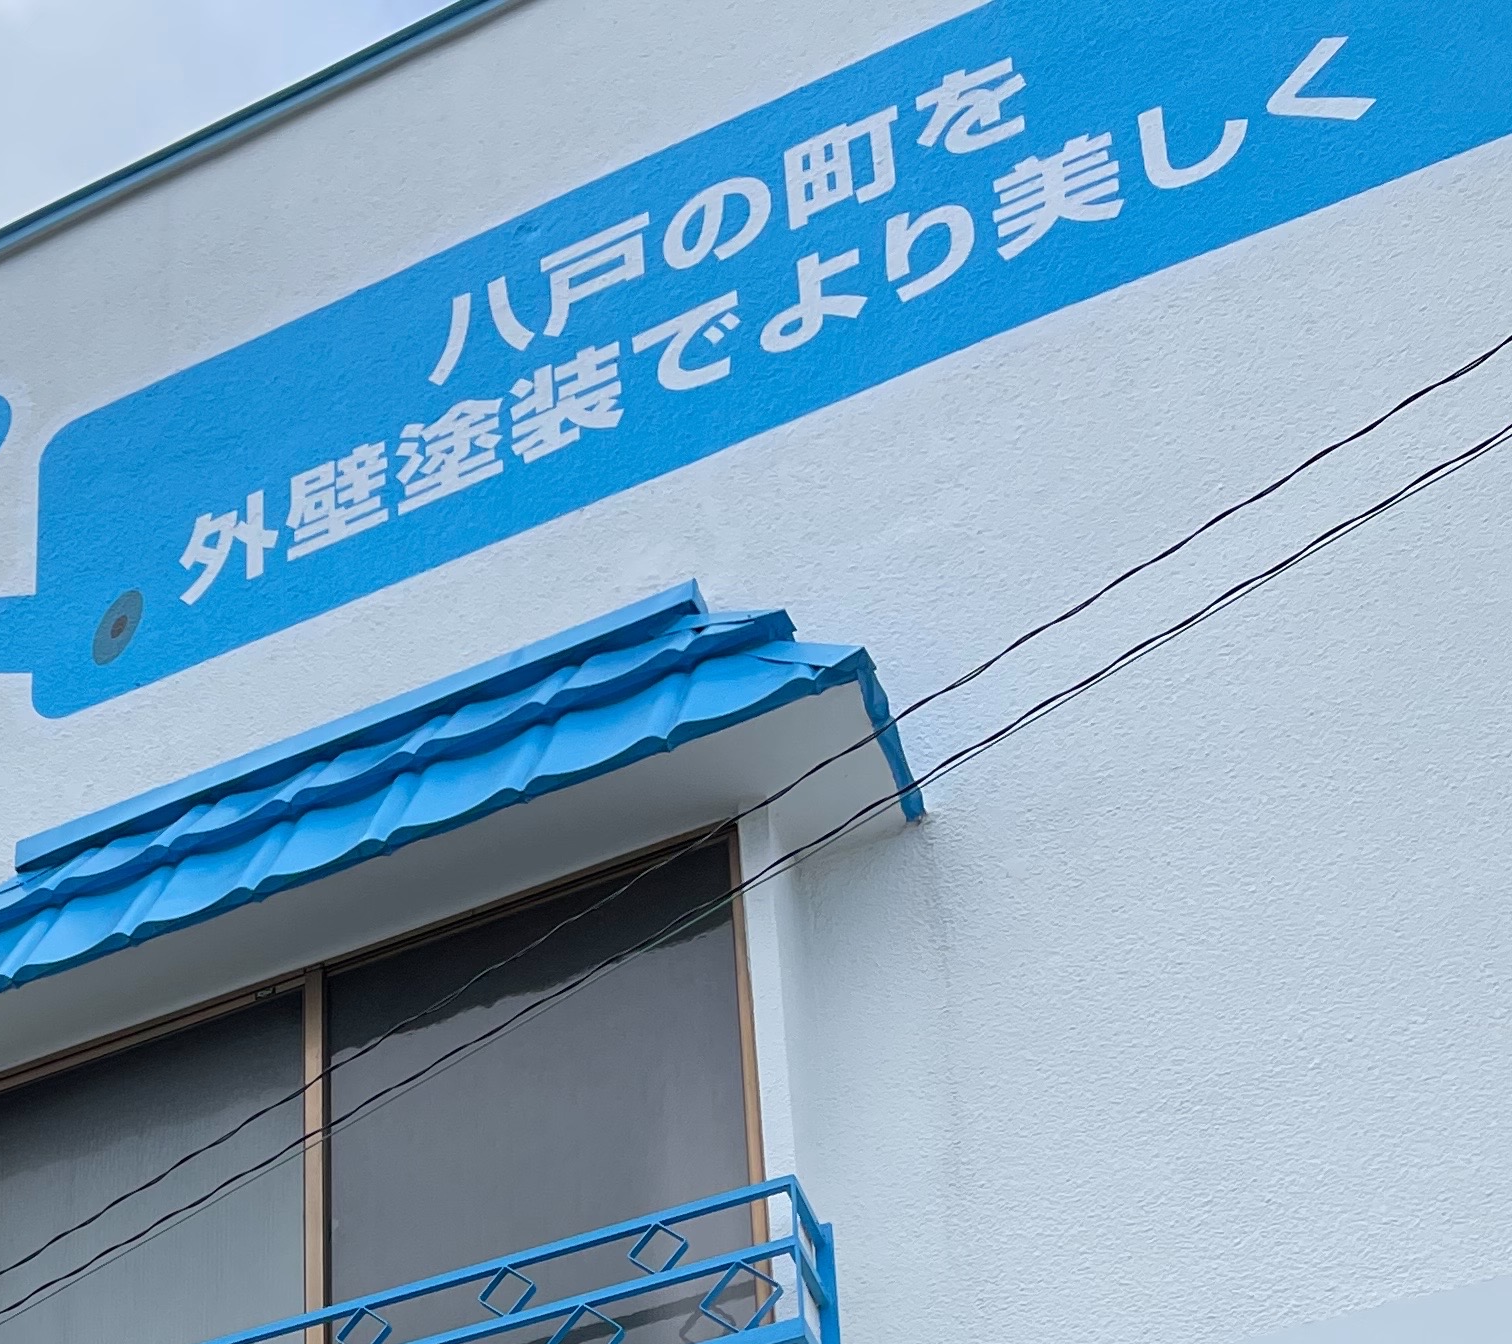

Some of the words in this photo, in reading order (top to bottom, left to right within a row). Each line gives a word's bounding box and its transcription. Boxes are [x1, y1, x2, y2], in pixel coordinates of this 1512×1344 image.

[178, 36, 1378, 605] 外壁塗装でより美しく
[428, 56, 1031, 387] 八戸の町を
